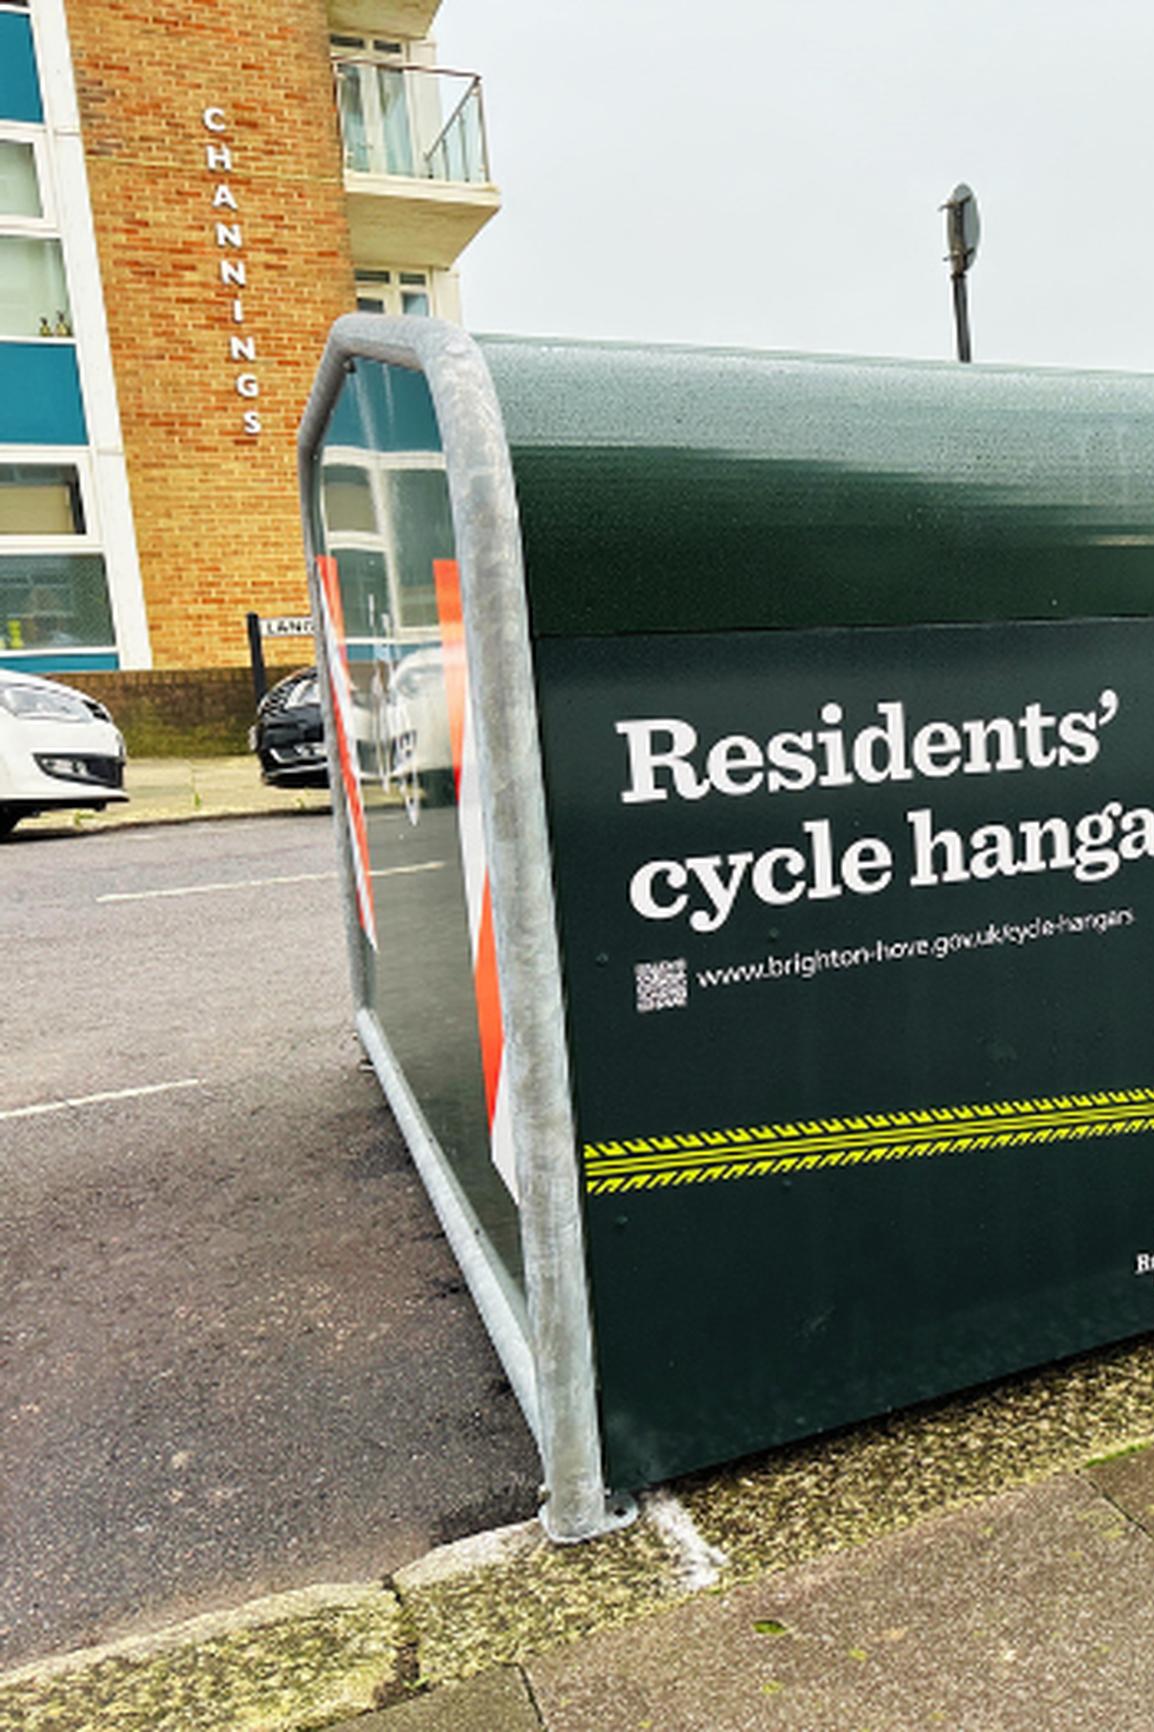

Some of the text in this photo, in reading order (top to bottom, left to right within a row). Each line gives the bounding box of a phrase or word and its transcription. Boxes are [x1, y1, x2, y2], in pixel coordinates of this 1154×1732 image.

[203, 107, 261, 435] CHANNINGS
[615, 688, 1120, 803] Residents’
[629, 819, 894, 933] cycle
[696, 906, 1136, 988] www.brighton-hove.gov.uk/cycle-hangers
